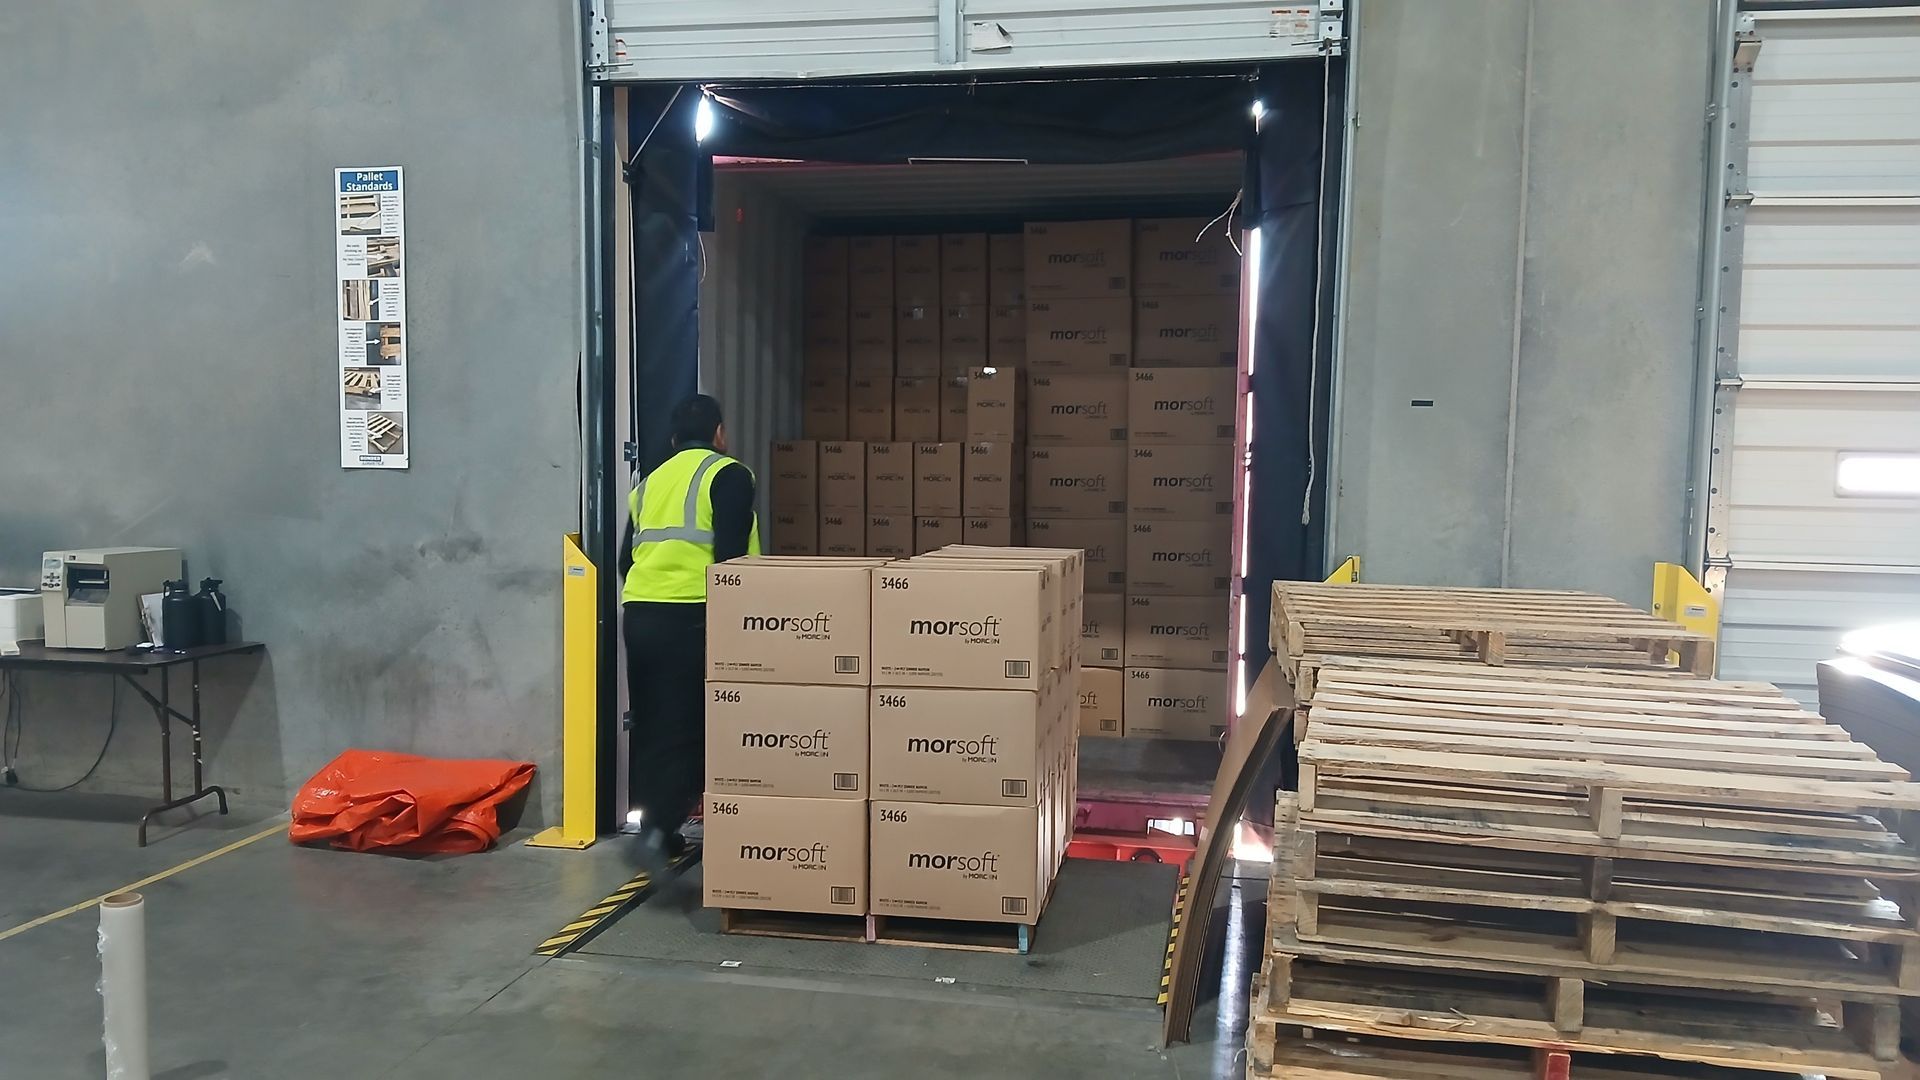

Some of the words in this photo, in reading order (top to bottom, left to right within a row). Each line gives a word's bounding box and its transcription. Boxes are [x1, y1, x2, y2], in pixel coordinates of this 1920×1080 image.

[356, 172, 384, 181] Pallet
[346, 181, 393, 192] Standards
[1050, 326, 1106, 340] morsoft
[1135, 373, 1154, 381] 3466
[1051, 400, 1107, 415] morsoft
[1154, 396, 1214, 411] morsoft
[825, 446, 842, 454] 3466
[872, 446, 889, 454] 3466
[920, 446, 937, 454] 3466
[1134, 449, 1152, 458] 3466
[1050, 474, 1106, 488] morsoft
[1153, 473, 1214, 488] morsoft
[922, 520, 939, 529] 3466
[971, 520, 989, 529] 3466
[1133, 524, 1151, 533] 3466
[1152, 547, 1212, 563] morsoft
[715, 574, 741, 587] 3466
[882, 577, 908, 590] 3466
[1131, 597, 1149, 606] 3466
[743, 612, 831, 633] morsoft
[910, 616, 1001, 637] morsoft
[1150, 622, 1209, 636] morsoft
[1131, 671, 1149, 679] 3466
[713, 690, 740, 703] 3466
[879, 695, 906, 708] 3466
[1147, 694, 1206, 709] morsoft
[742, 730, 829, 751] morsoft
[908, 735, 999, 756] morsoft
[712, 802, 739, 816] 3466
[880, 809, 907, 823] 3466
[740, 843, 827, 863] morsoft
[909, 852, 999, 872] morsoft
